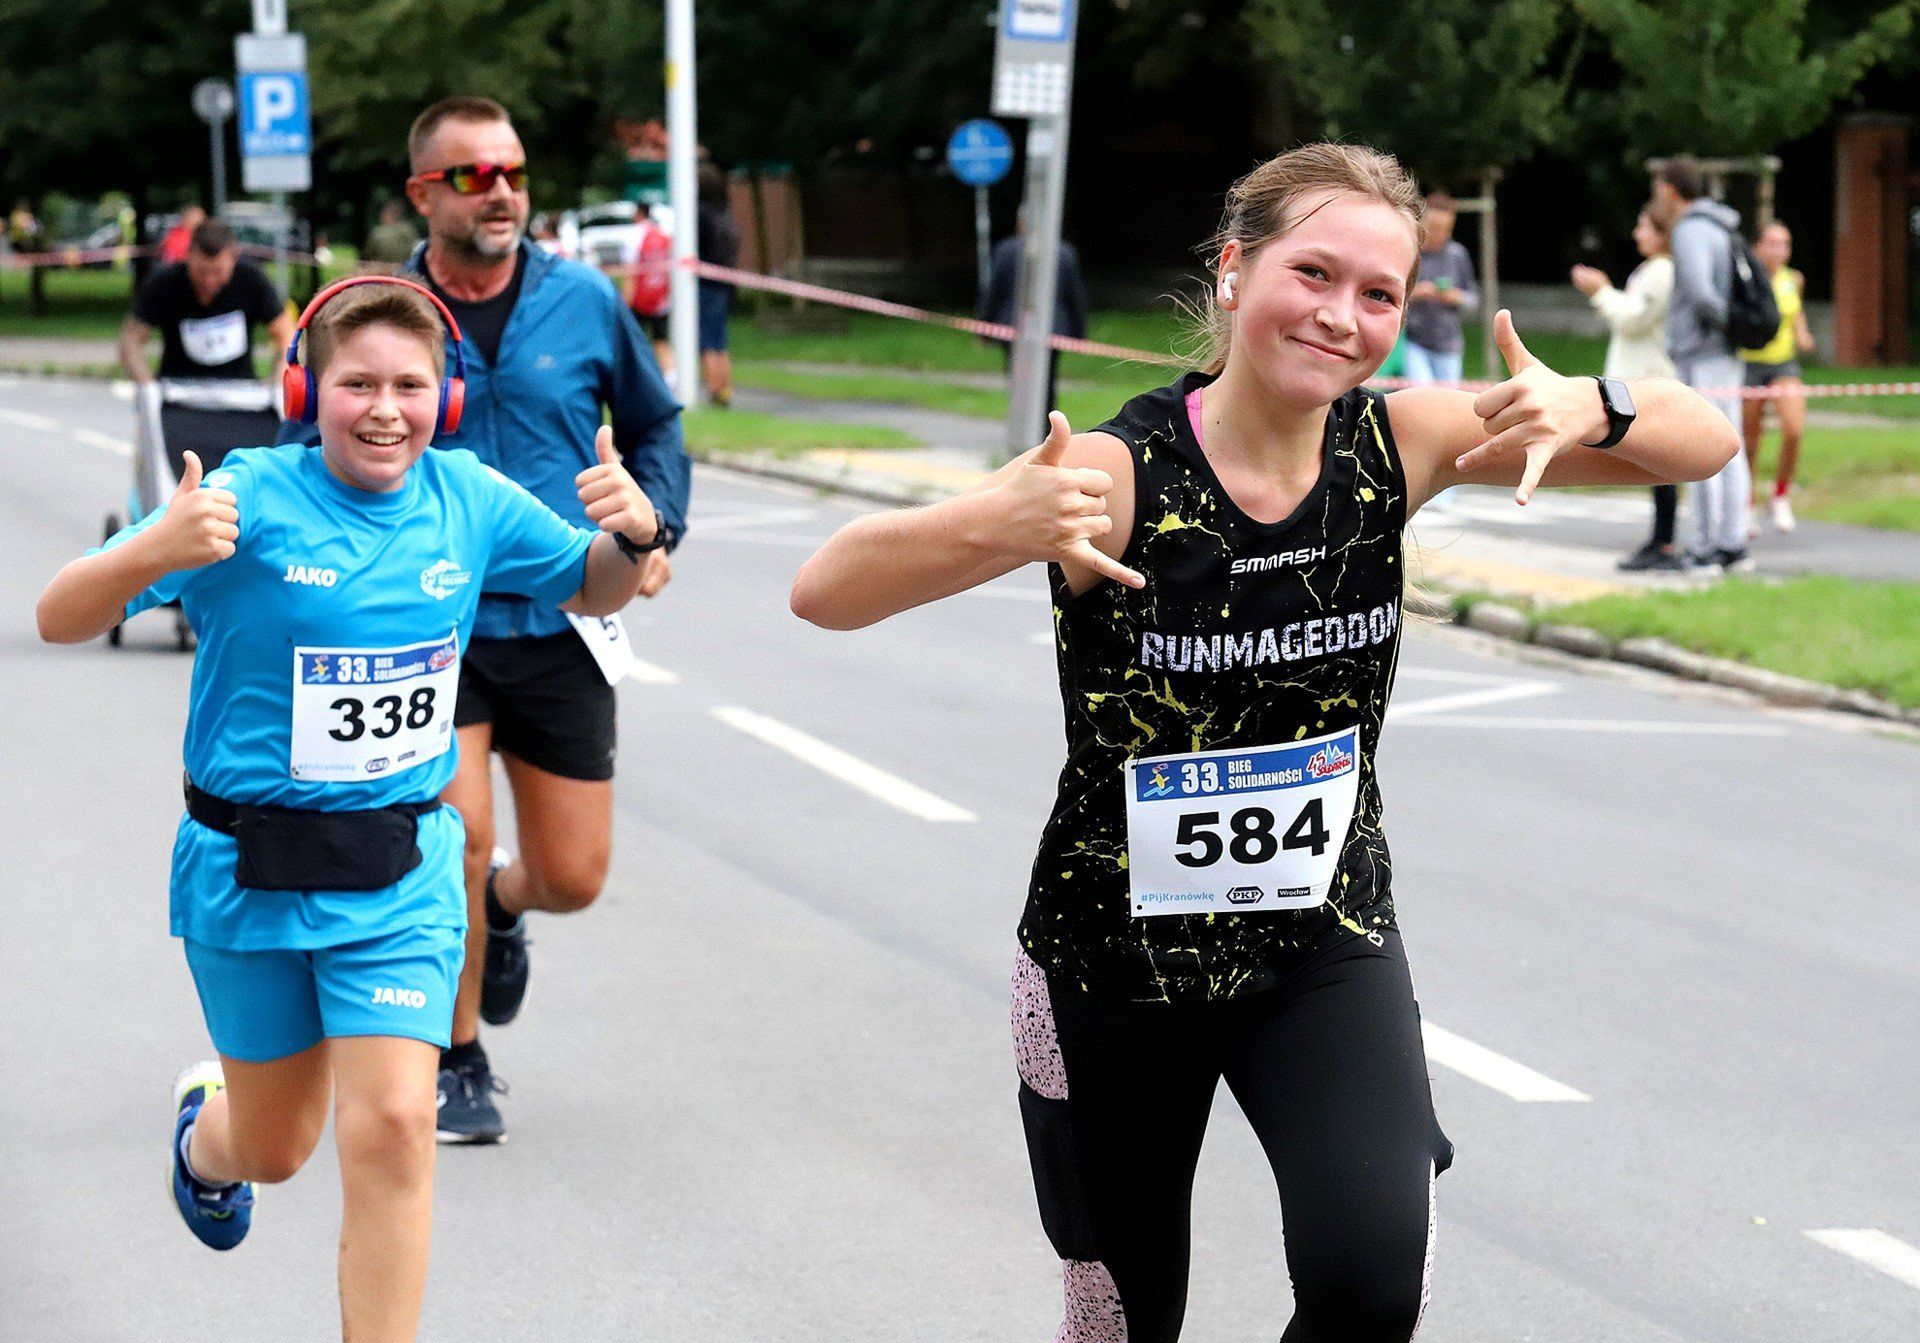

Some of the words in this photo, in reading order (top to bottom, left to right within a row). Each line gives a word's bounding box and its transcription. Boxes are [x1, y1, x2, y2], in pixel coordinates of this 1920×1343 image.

[255, 78, 296, 131] P
[1230, 546, 1326, 574] SMMASH
[284, 564, 337, 587] JAKO
[1141, 596, 1398, 673] RUNMAGEDDON
[337, 656, 371, 683] 33.
[328, 687, 436, 742] 338
[1181, 762, 1224, 794] 33.
[1228, 760, 1252, 773] BIEG
[1228, 768, 1302, 790] SOLIDARNOŚCI
[1174, 798, 1330, 868] 584
[1141, 892, 1215, 903] #PijKranówkę
[1232, 891, 1259, 900] PKP
[371, 987, 426, 1009] JAKO
